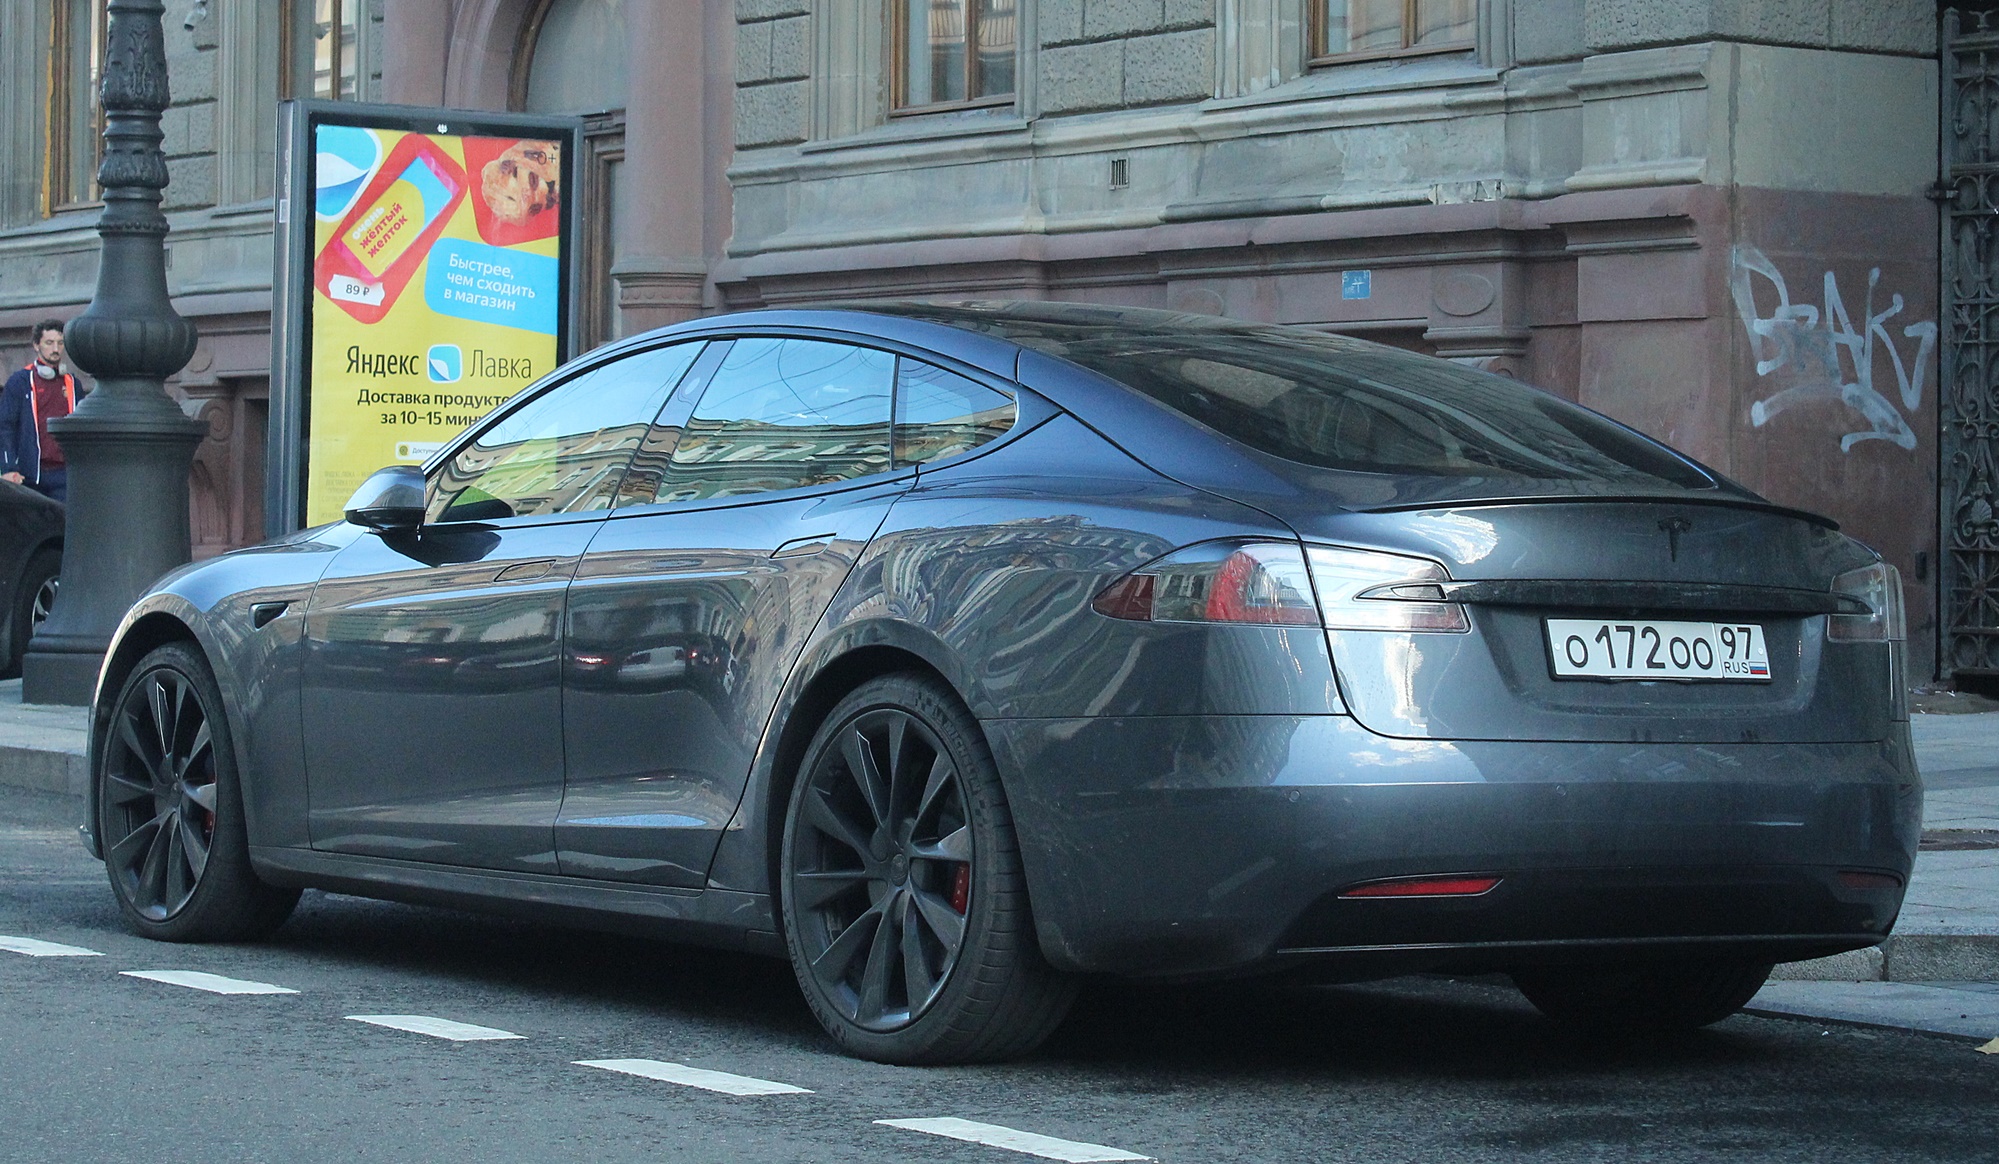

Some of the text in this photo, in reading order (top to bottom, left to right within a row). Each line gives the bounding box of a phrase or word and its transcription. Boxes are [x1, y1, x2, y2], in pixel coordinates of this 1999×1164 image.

[352, 207, 385, 240] очень
[360, 202, 403, 249] жёлтый
[368, 214, 408, 258] желток
[449, 253, 515, 280] Быстрее,
[345, 283, 361, 296] 89
[447, 272, 536, 299] чем сходить
[444, 288, 516, 311] в магазин
[346, 345, 532, 379] Яндекс Лавка
[357, 389, 430, 406] Доставка
[380, 413, 397, 425] за
[445, 415, 481, 426] мин
[1720, 627, 1751, 660] 97
[1724, 662, 1749, 674] RUS
